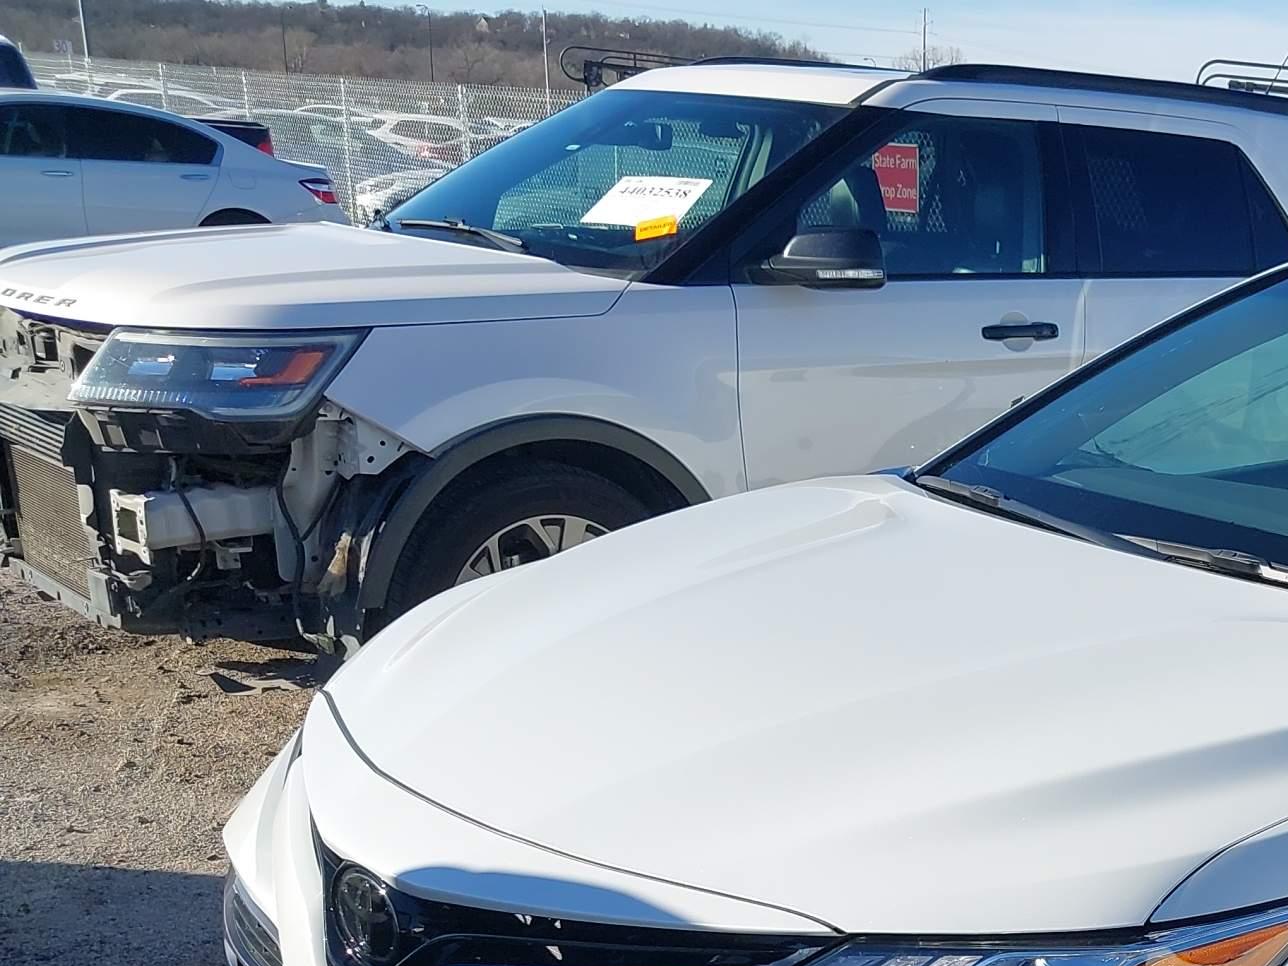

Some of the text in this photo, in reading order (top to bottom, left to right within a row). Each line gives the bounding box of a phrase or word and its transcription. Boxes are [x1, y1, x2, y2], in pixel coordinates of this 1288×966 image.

[874, 152, 917, 169] State Farm
[618, 186, 692, 199] 44032538
[881, 184, 917, 200] rop Zone
